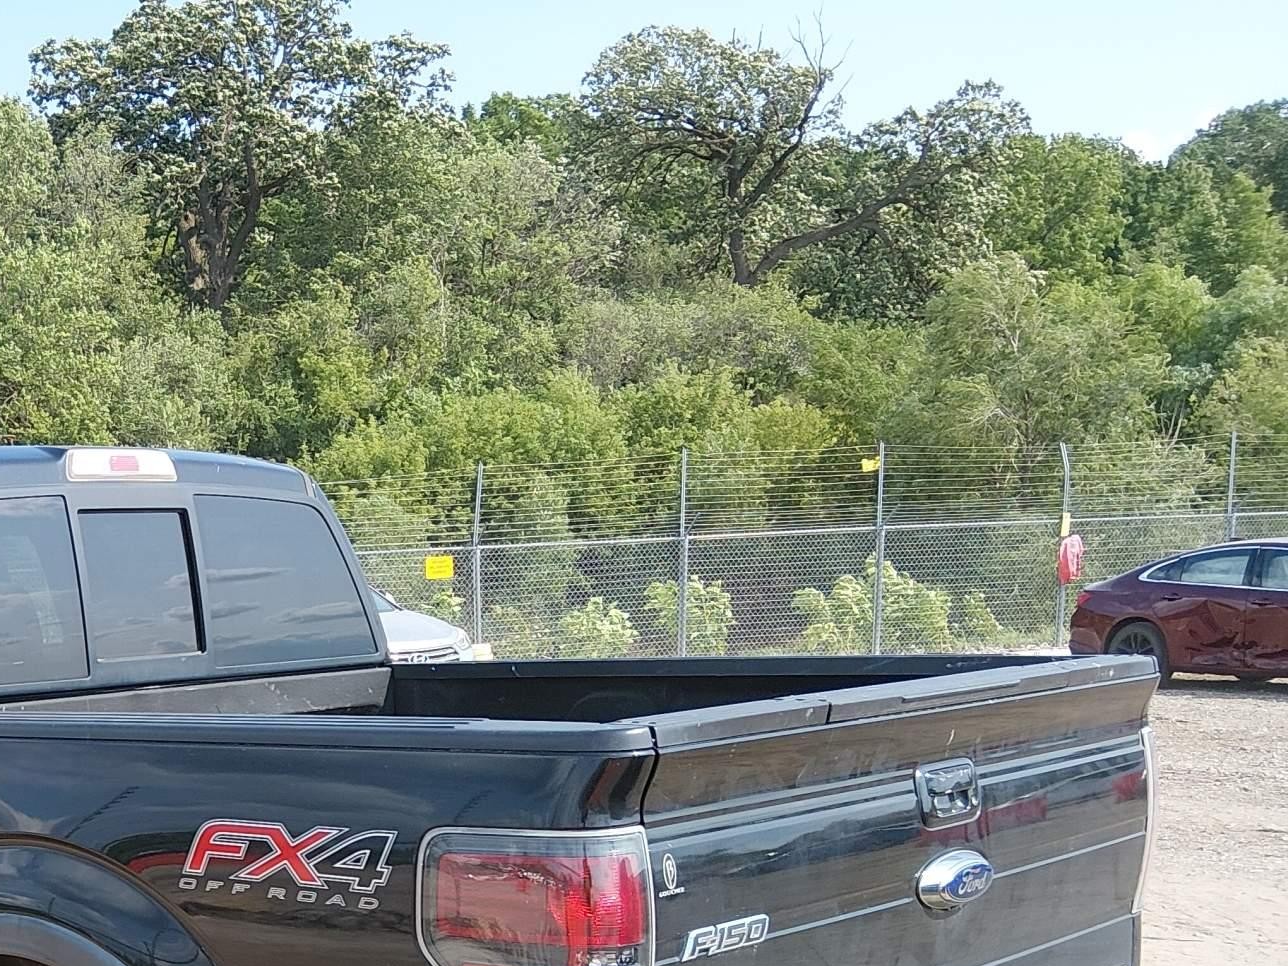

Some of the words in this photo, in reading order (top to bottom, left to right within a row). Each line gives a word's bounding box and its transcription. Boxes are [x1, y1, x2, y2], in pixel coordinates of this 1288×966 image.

[181, 818, 400, 895] FX4
[178, 877, 250, 895] OFF
[267, 886, 381, 911] ROAD
[957, 867, 988, 895] Ford
[681, 913, 770, 962] F-150
